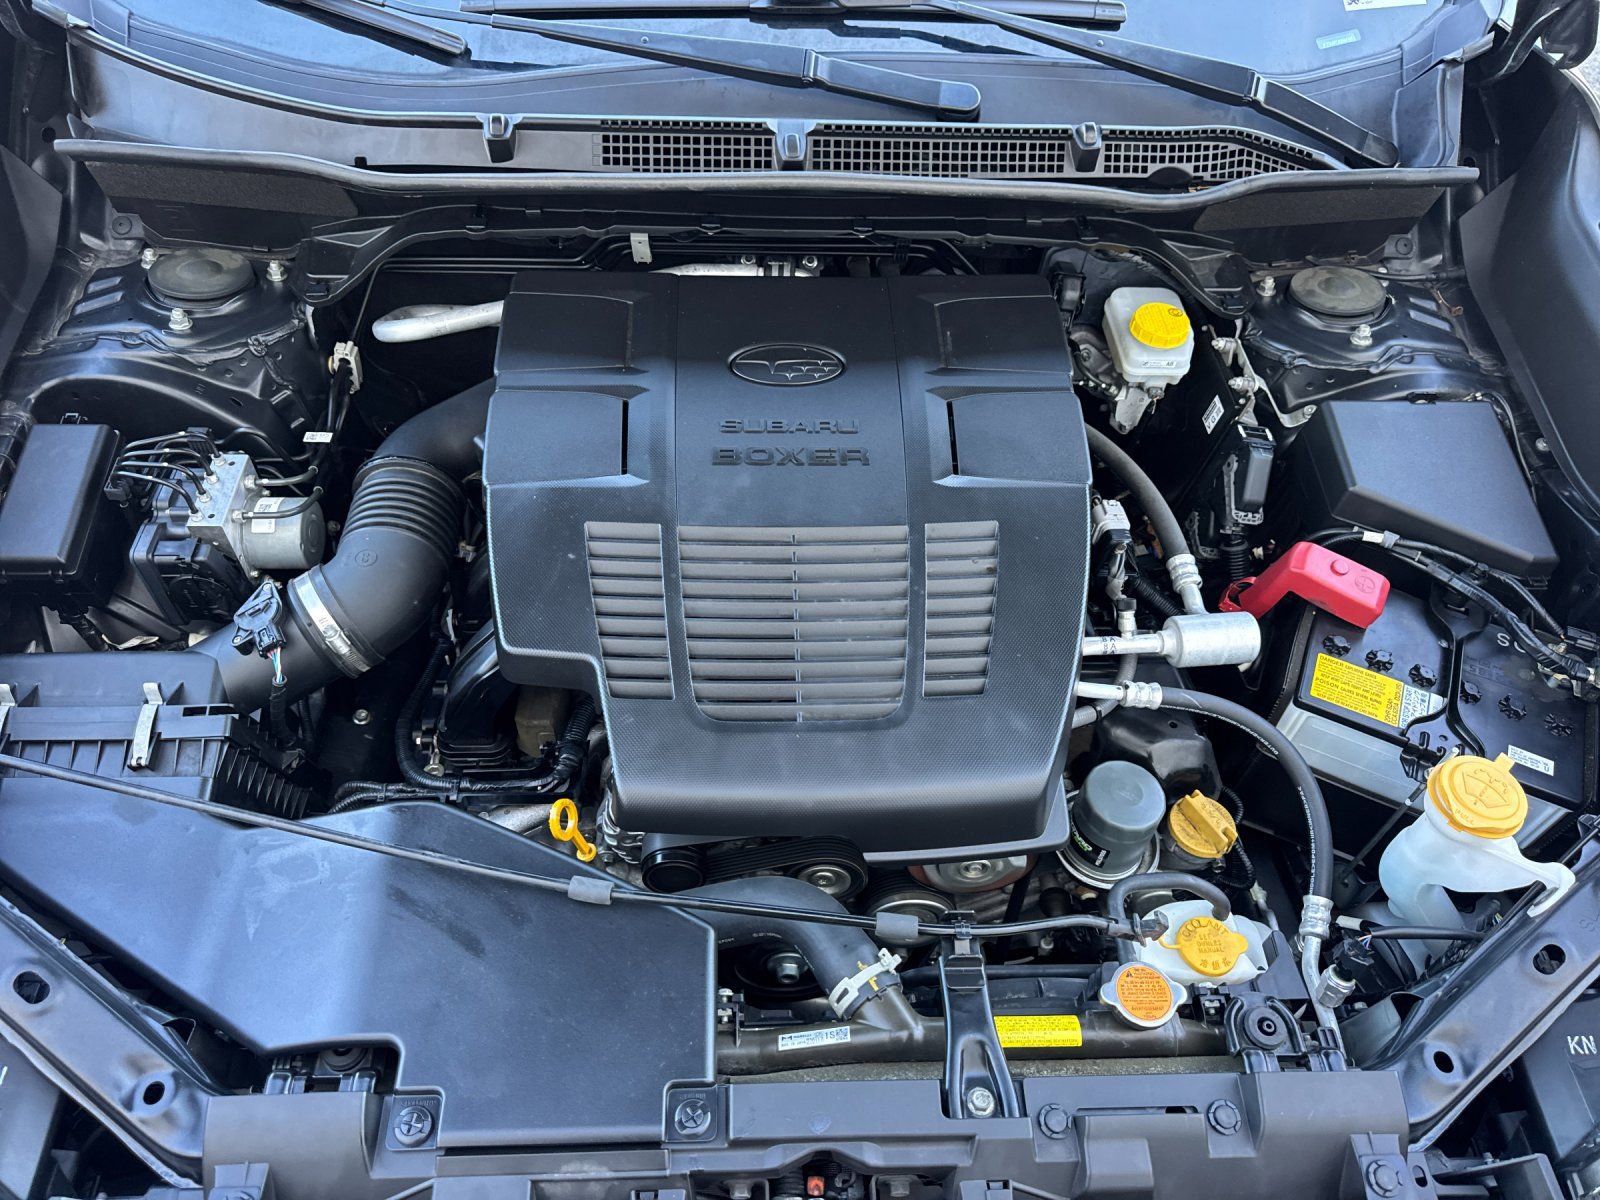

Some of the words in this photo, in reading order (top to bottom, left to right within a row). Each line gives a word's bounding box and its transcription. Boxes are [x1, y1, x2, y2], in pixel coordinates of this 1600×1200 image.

[719, 418, 861, 435] SUBARU
[712, 446, 871, 466] BOXER
[1319, 655, 1344, 667] DANGER
[1315, 676, 1339, 690] POISON
[1181, 918, 1229, 938] COOLANT
[1567, 1035, 1597, 1055] KN
